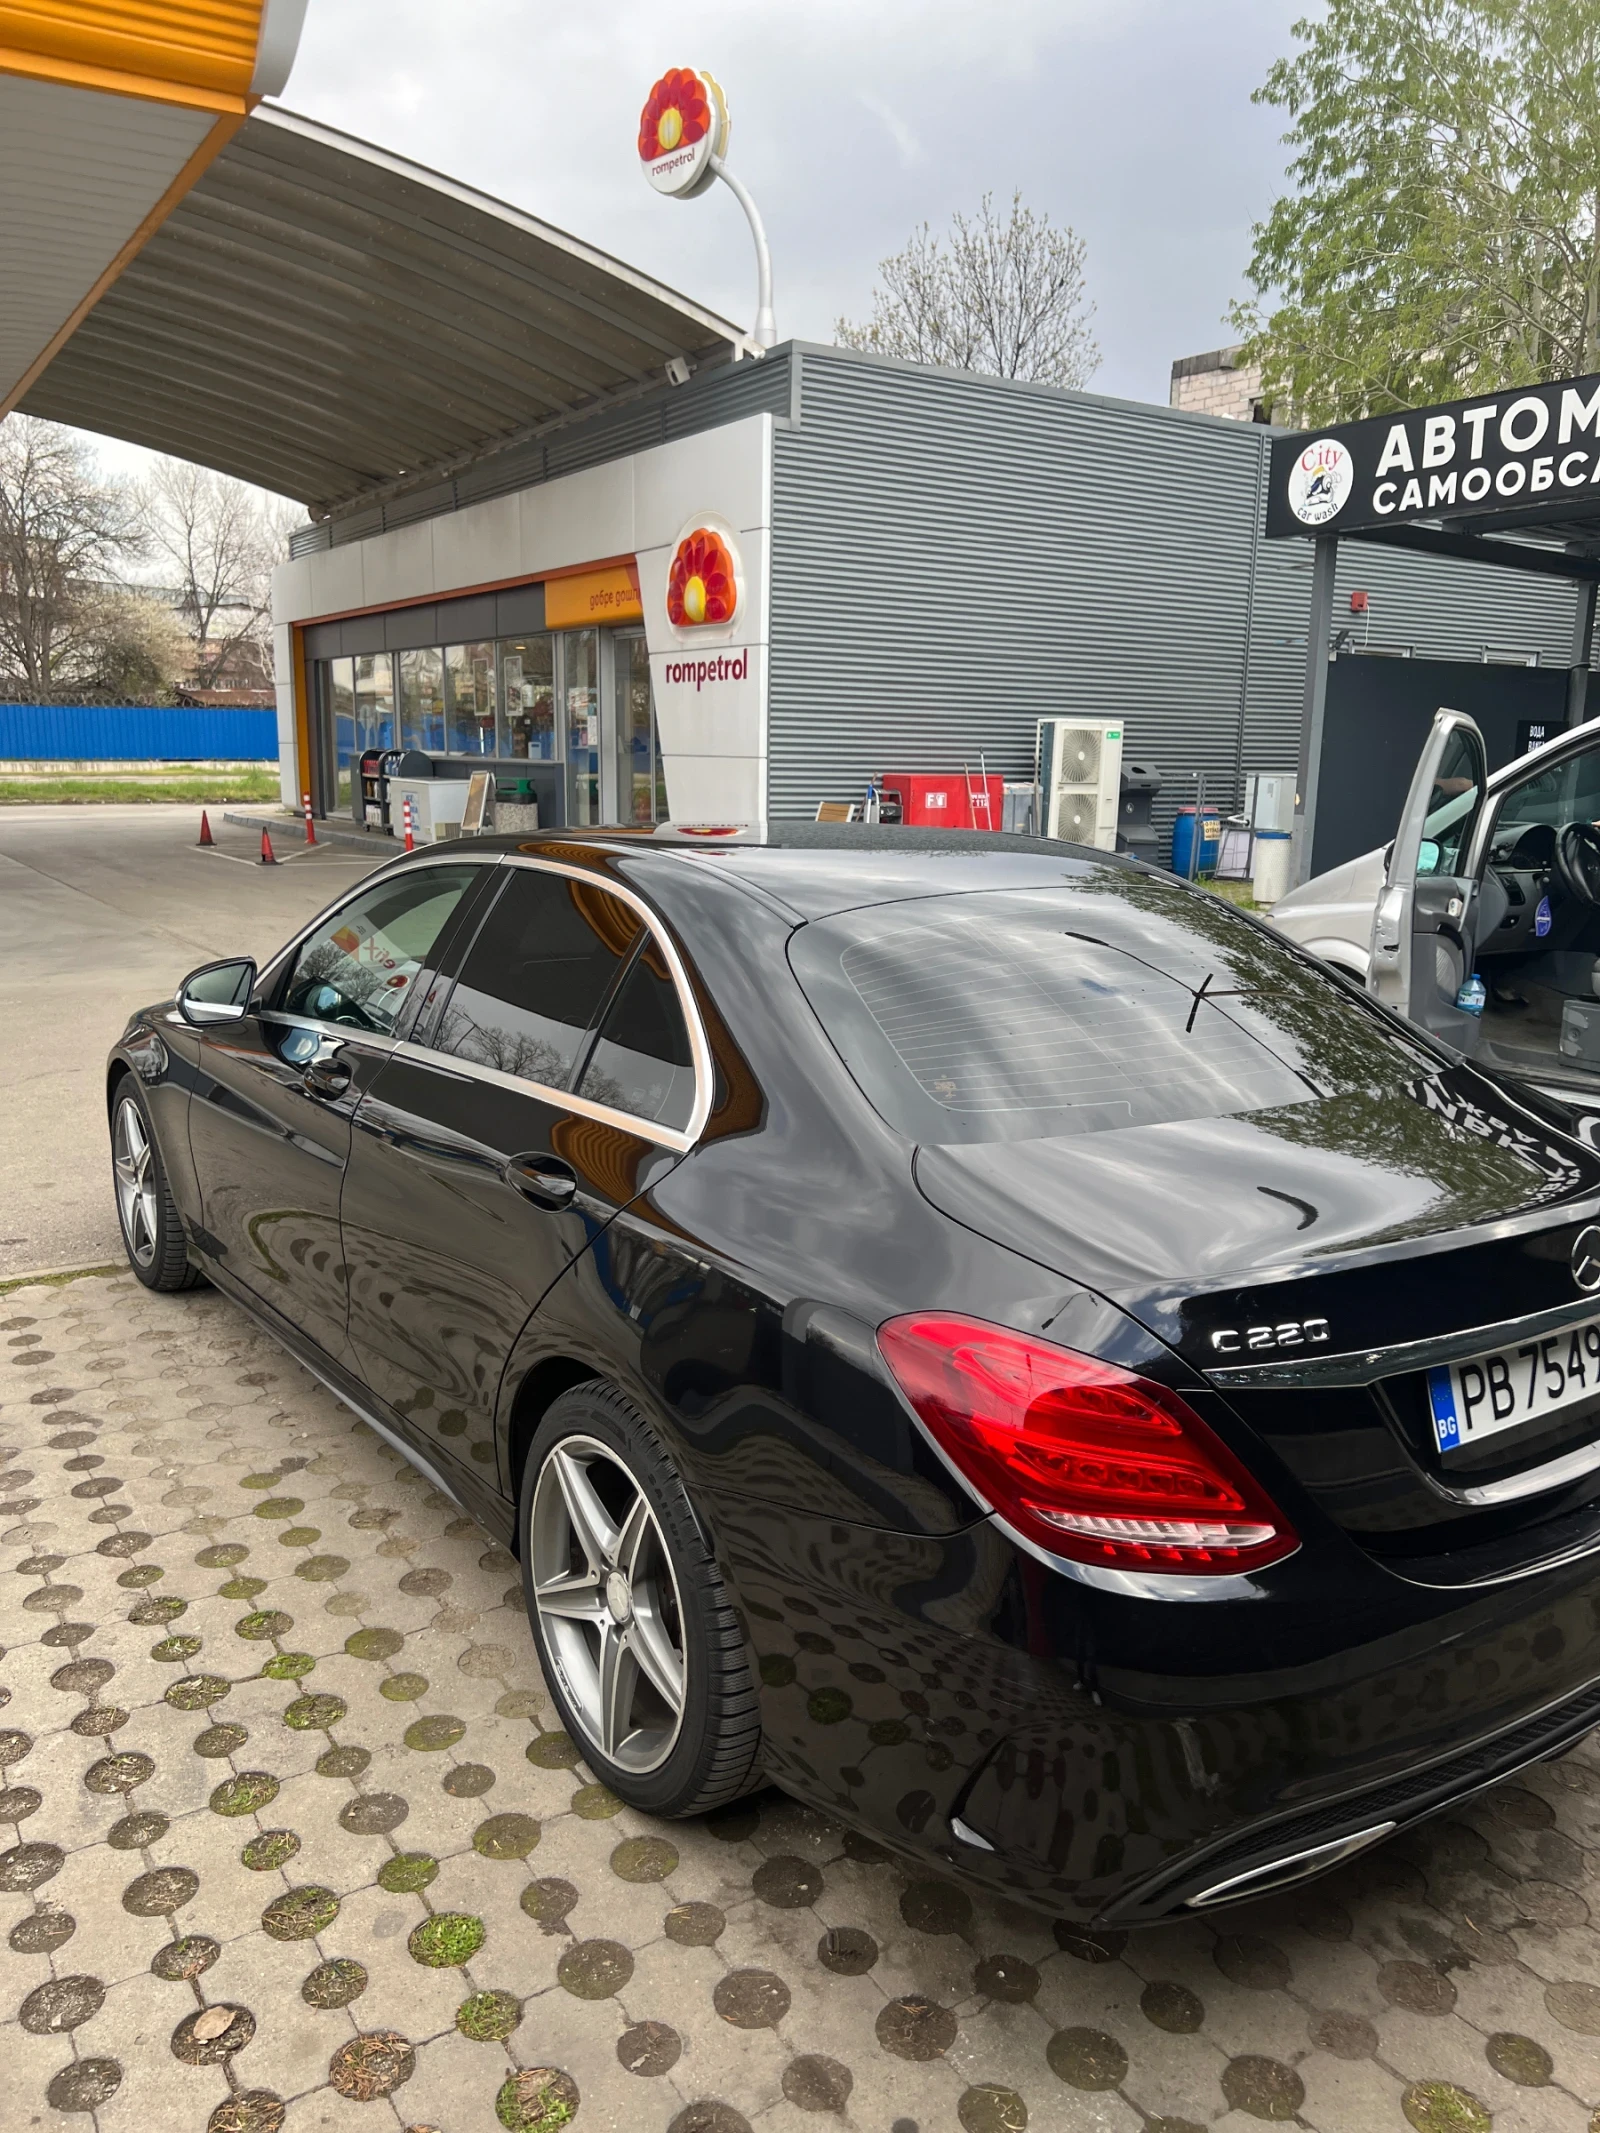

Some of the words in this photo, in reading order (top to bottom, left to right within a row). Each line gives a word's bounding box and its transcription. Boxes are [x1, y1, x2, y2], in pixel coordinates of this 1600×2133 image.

[651, 147, 695, 176] rompetrol
[1301, 445, 1343, 471] City
[1297, 507, 1312, 520] car
[1314, 502, 1338, 521] wash
[666, 648, 747, 692] rompetrol
[1212, 1330, 1241, 1352] C
[1246, 1318, 1331, 1350] 220
[1458, 1355, 1515, 1430] PB
[1437, 1416, 1456, 1438] BG
